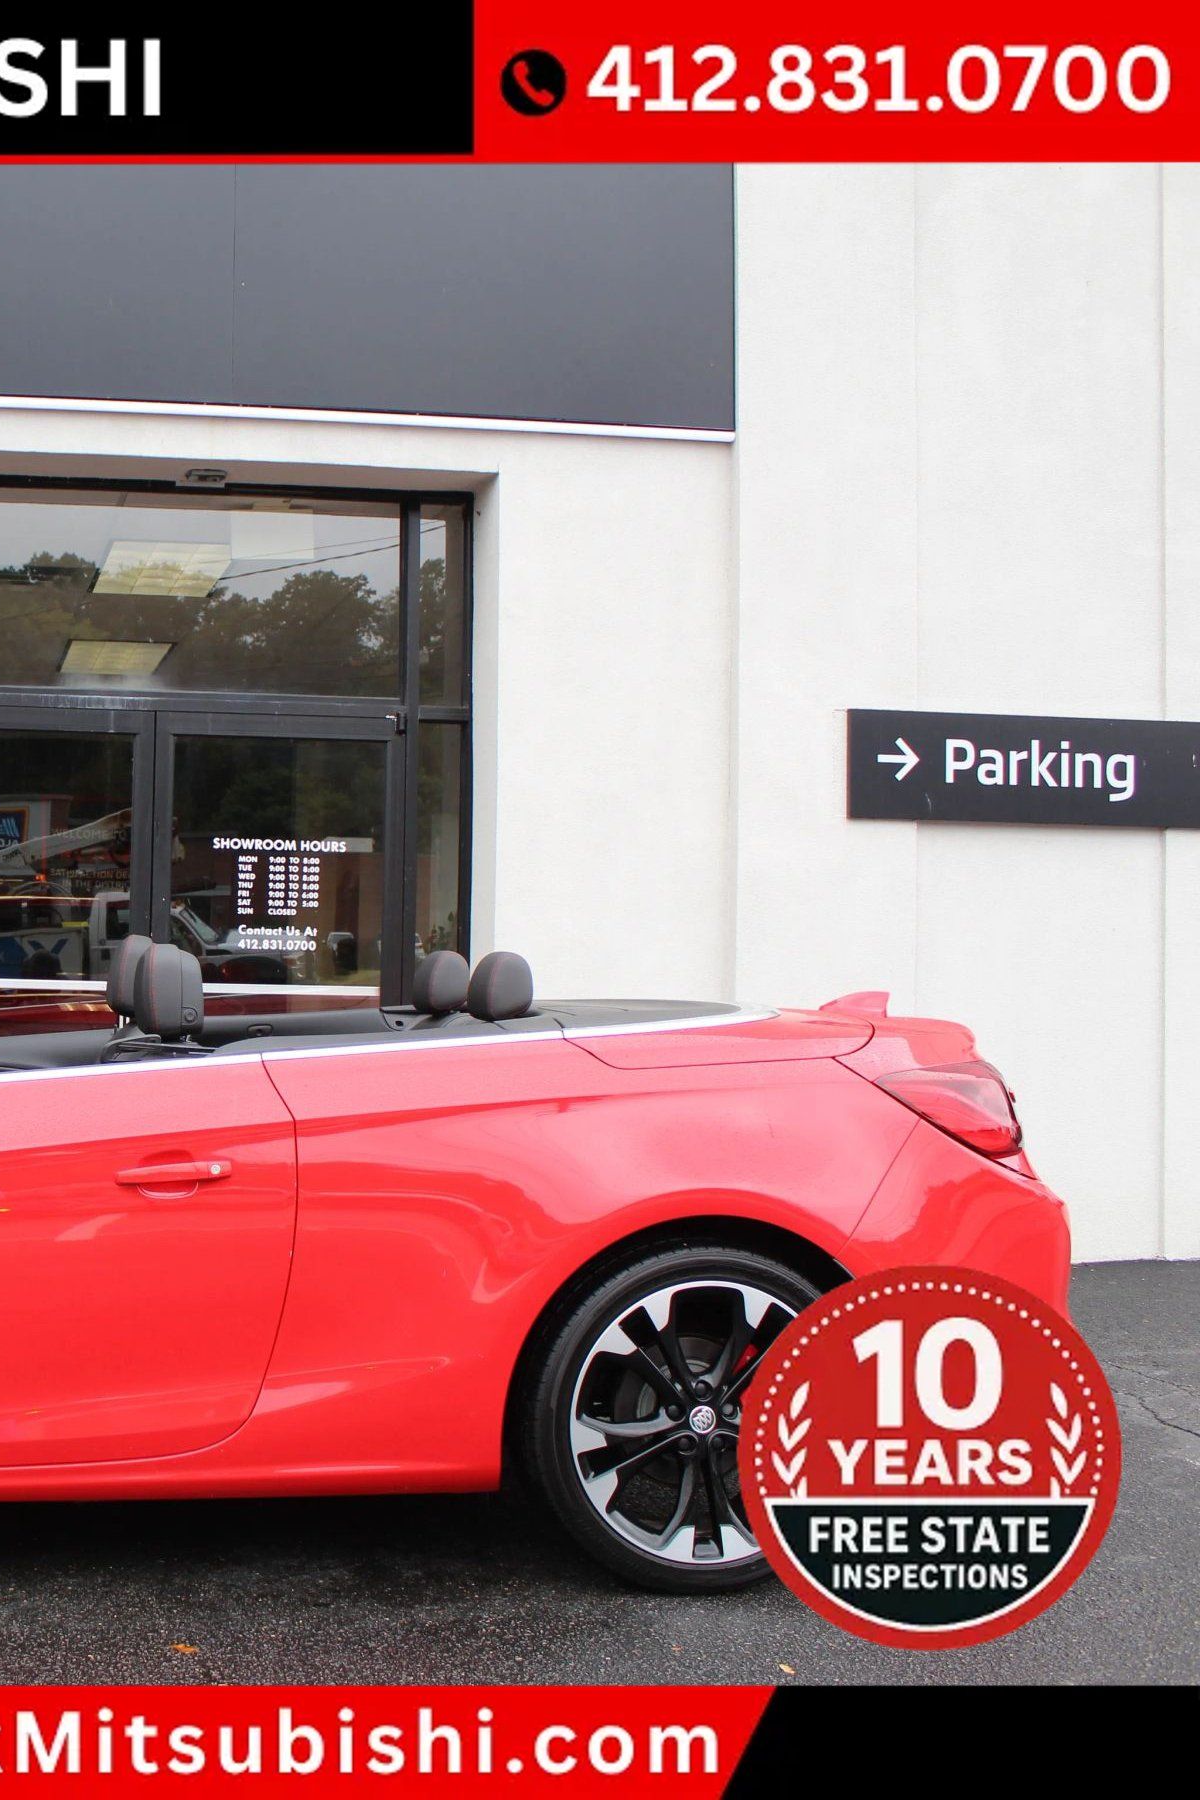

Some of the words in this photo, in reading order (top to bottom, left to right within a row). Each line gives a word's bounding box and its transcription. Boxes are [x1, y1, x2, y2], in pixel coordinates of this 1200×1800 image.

[945, 738, 1136, 802] Parking
[212, 837, 297, 851] SHOWROOM
[300, 840, 347, 853] HOURS
[238, 855, 258, 863] MON
[268, 856, 286, 864] 9:00
[238, 864, 253, 872] TUE
[268, 873, 286, 881] 9:00
[238, 881, 254, 889] THU
[268, 882, 285, 890] 9:00
[288, 891, 299, 899] TO
[302, 900, 319, 908] 5:00
[237, 907, 254, 915] SUN
[267, 908, 297, 916] CLOSED
[238, 924, 283, 936] Contact
[285, 925, 301, 936] Us
[303, 926, 318, 937] At
[237, 938, 317, 951] 412.831.0700
